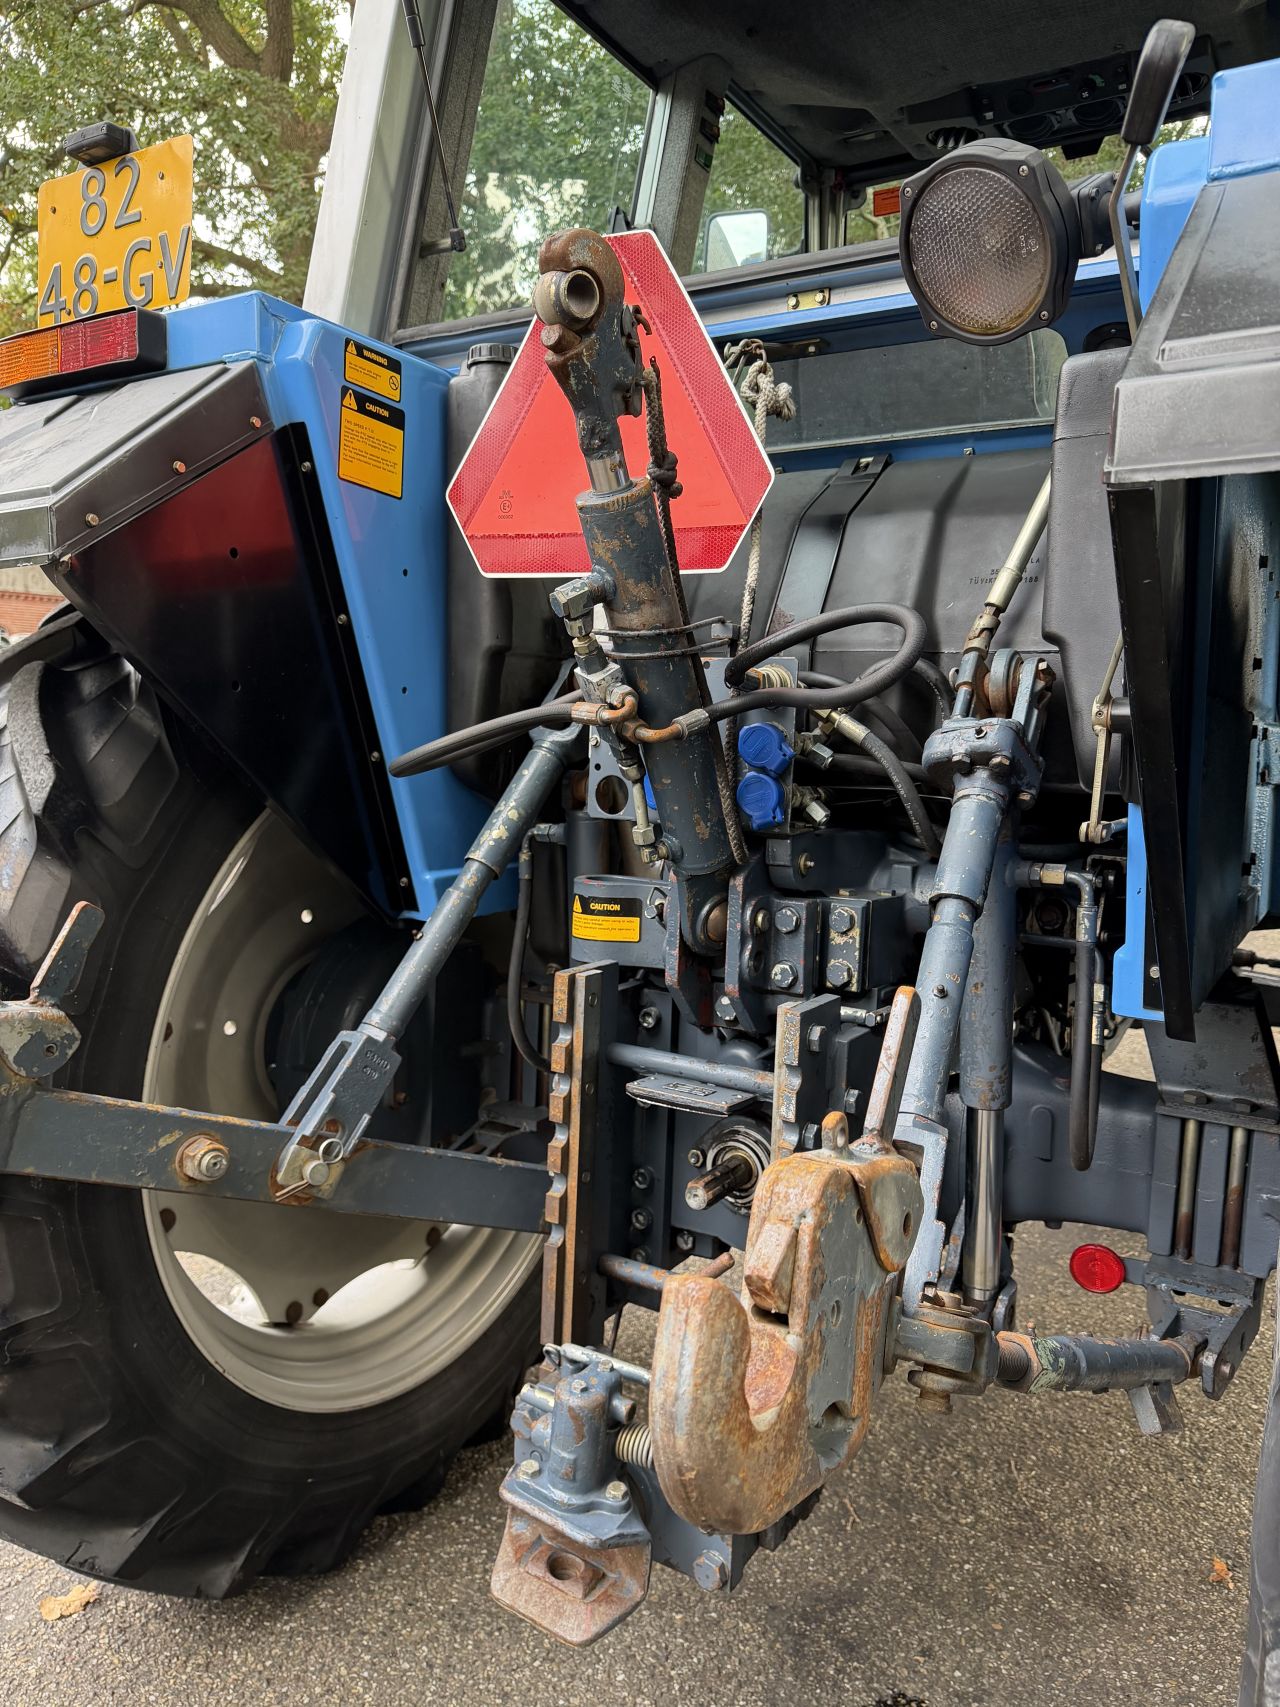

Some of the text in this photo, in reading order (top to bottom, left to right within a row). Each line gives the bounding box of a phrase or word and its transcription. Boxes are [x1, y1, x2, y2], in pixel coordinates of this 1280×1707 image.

[80, 156, 142, 237] 82
[40, 225, 191, 324] 48-GV
[362, 348, 388, 366] WARNING
[365, 402, 389, 418] CAUTION
[589, 902, 621, 911] CAUTION
